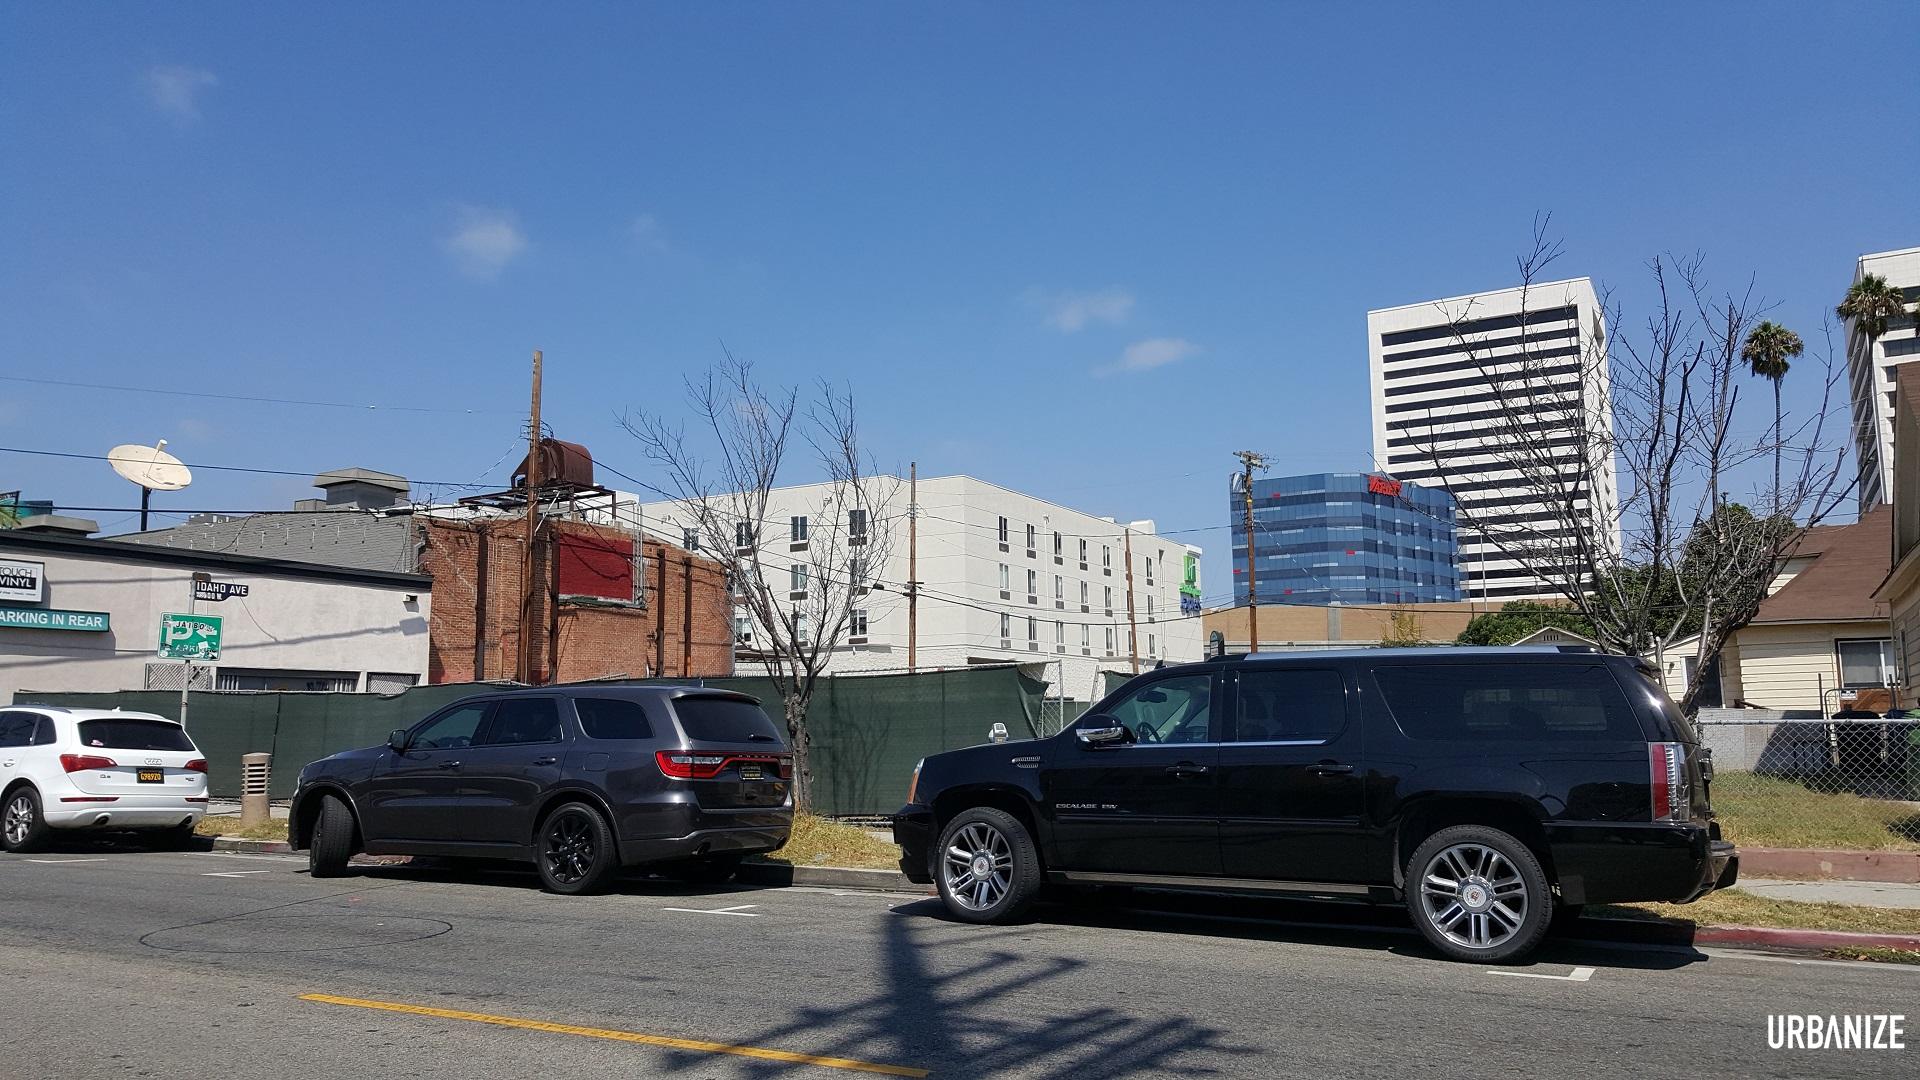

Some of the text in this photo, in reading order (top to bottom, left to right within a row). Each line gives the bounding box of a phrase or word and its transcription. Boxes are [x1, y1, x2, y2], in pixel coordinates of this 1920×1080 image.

[196, 582, 248, 595] IDAHO AVE
[52, 614, 65, 625] IN
[68, 615, 102, 628] REAR
